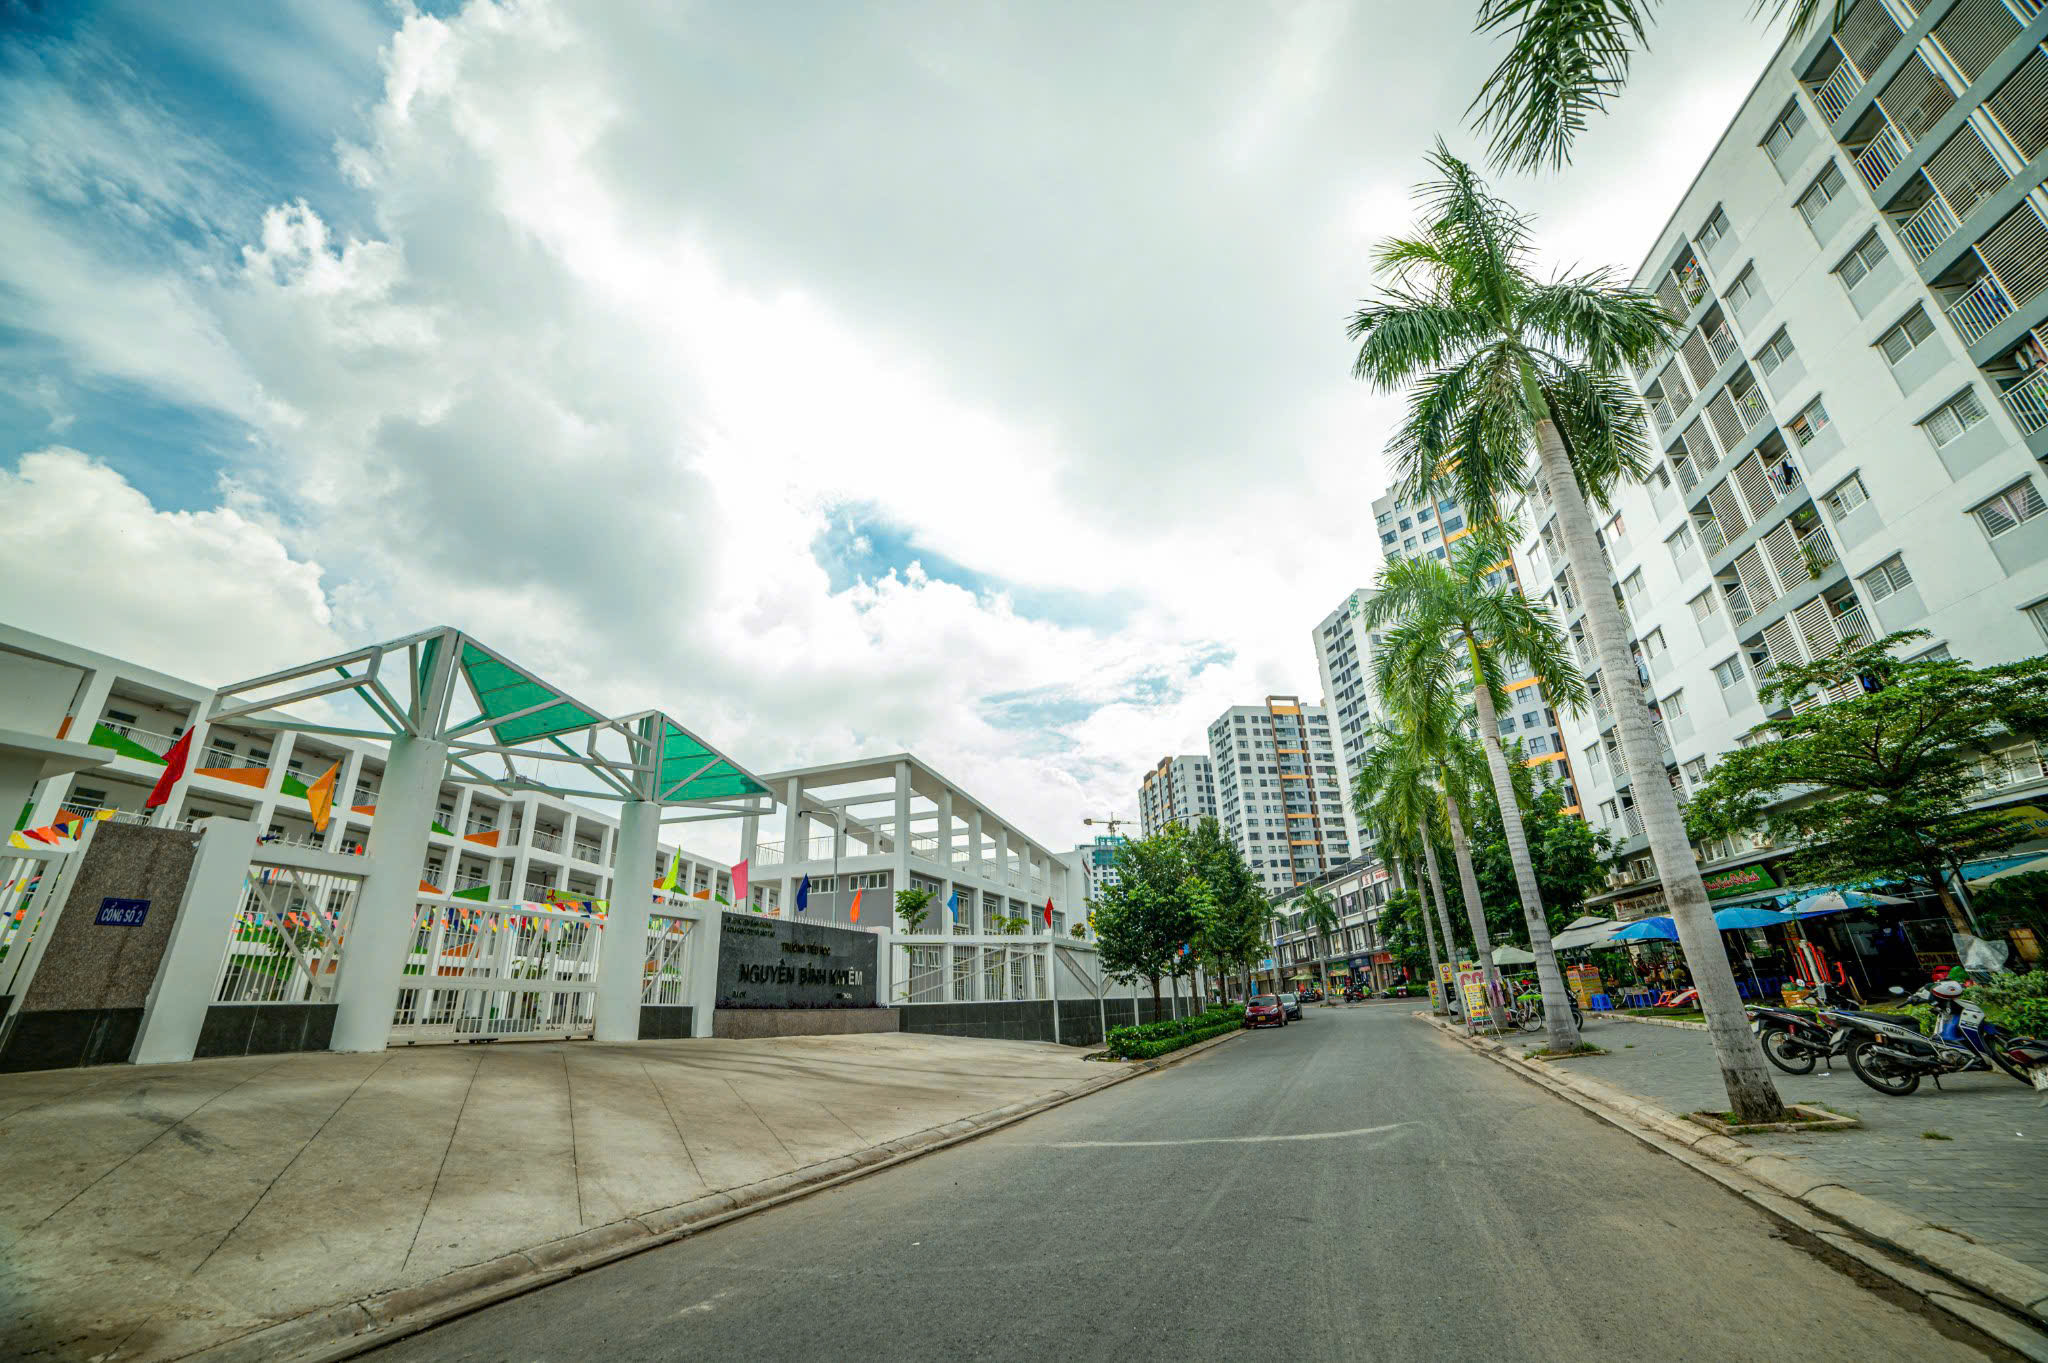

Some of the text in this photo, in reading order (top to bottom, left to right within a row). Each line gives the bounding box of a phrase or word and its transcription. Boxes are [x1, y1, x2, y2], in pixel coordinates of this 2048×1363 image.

[101, 901, 143, 923] CỔNG SỐ 2
[1882, 1026, 1904, 1036] YAMAHA
